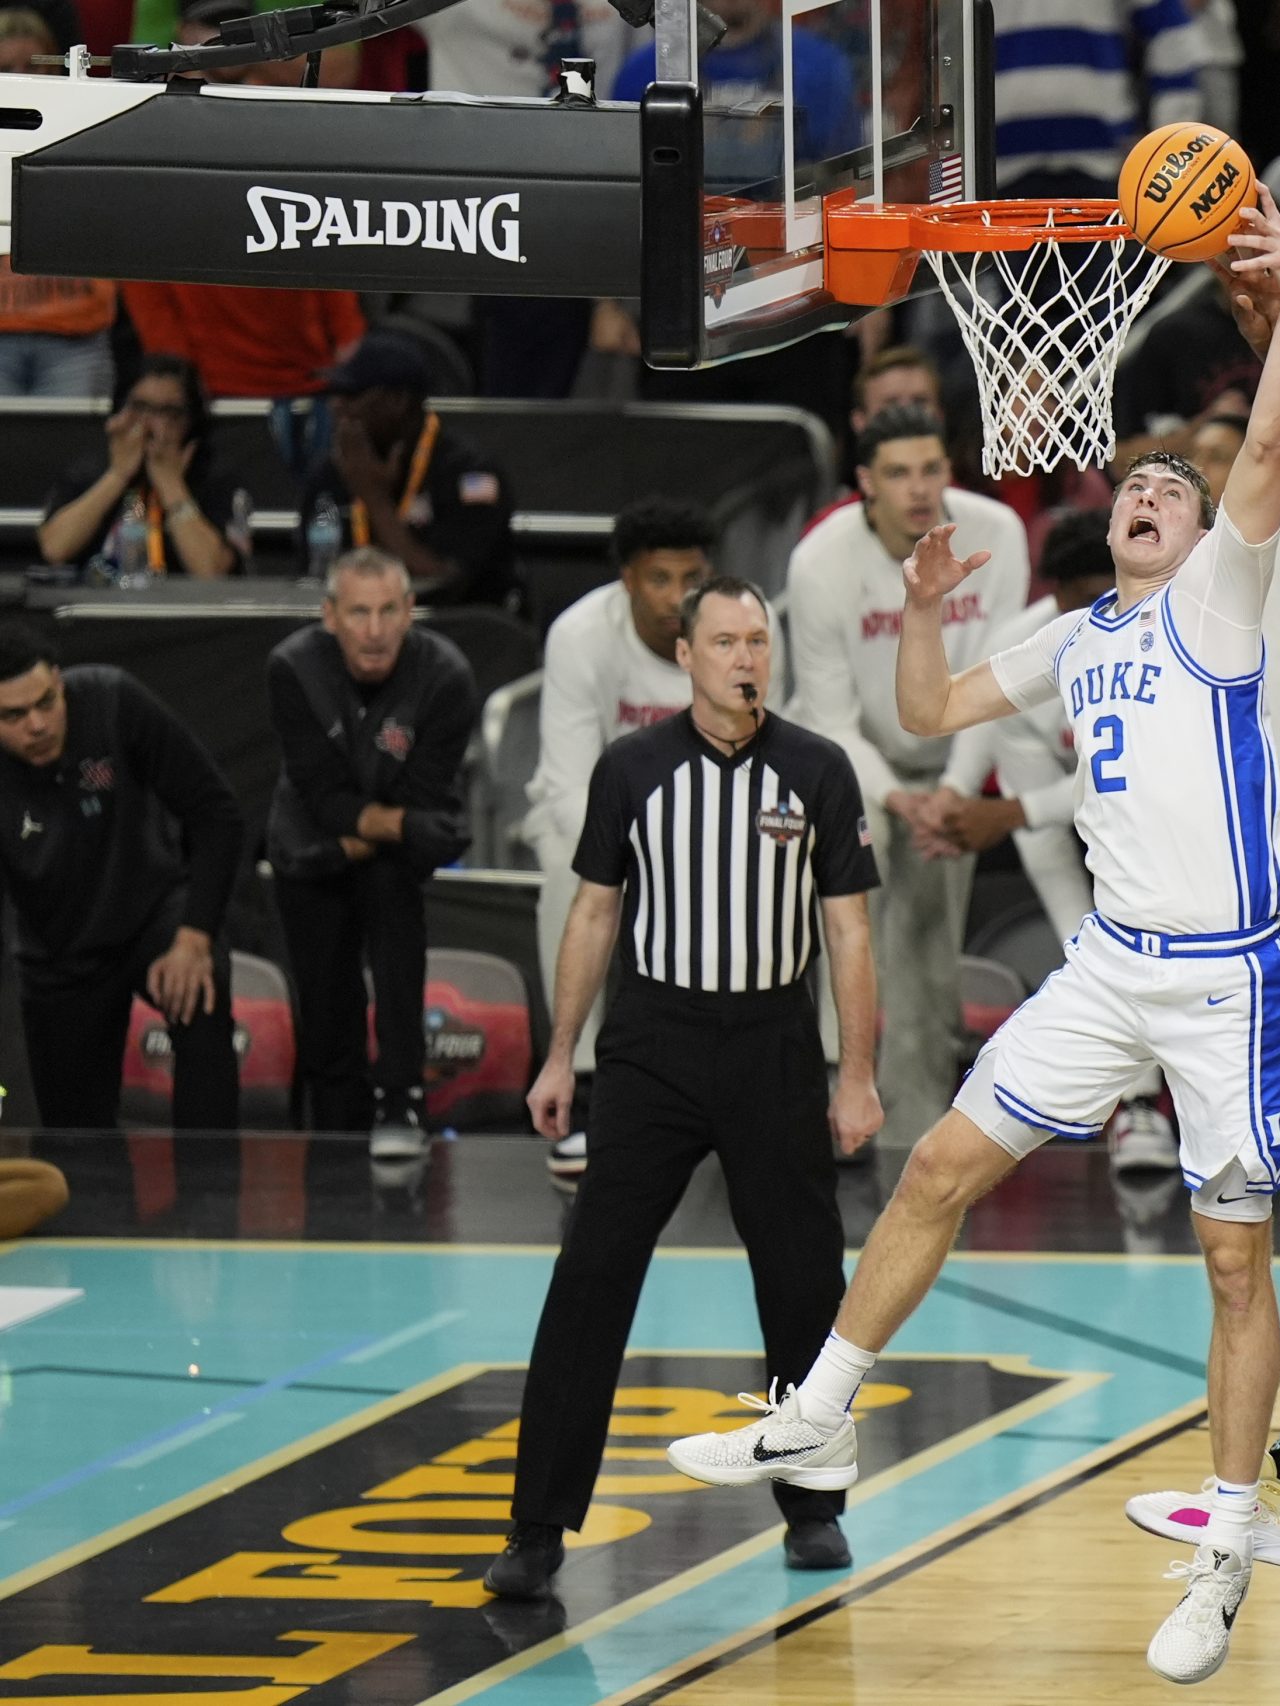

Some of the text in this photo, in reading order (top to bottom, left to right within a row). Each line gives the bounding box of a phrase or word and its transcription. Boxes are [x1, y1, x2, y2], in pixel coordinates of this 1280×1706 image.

[1144, 132, 1217, 203] Wilson
[1190, 162, 1240, 221] NCAA
[247, 186, 520, 263] SPALDING
[1071, 662, 1162, 719] DUKE
[1091, 714, 1127, 793] 2
